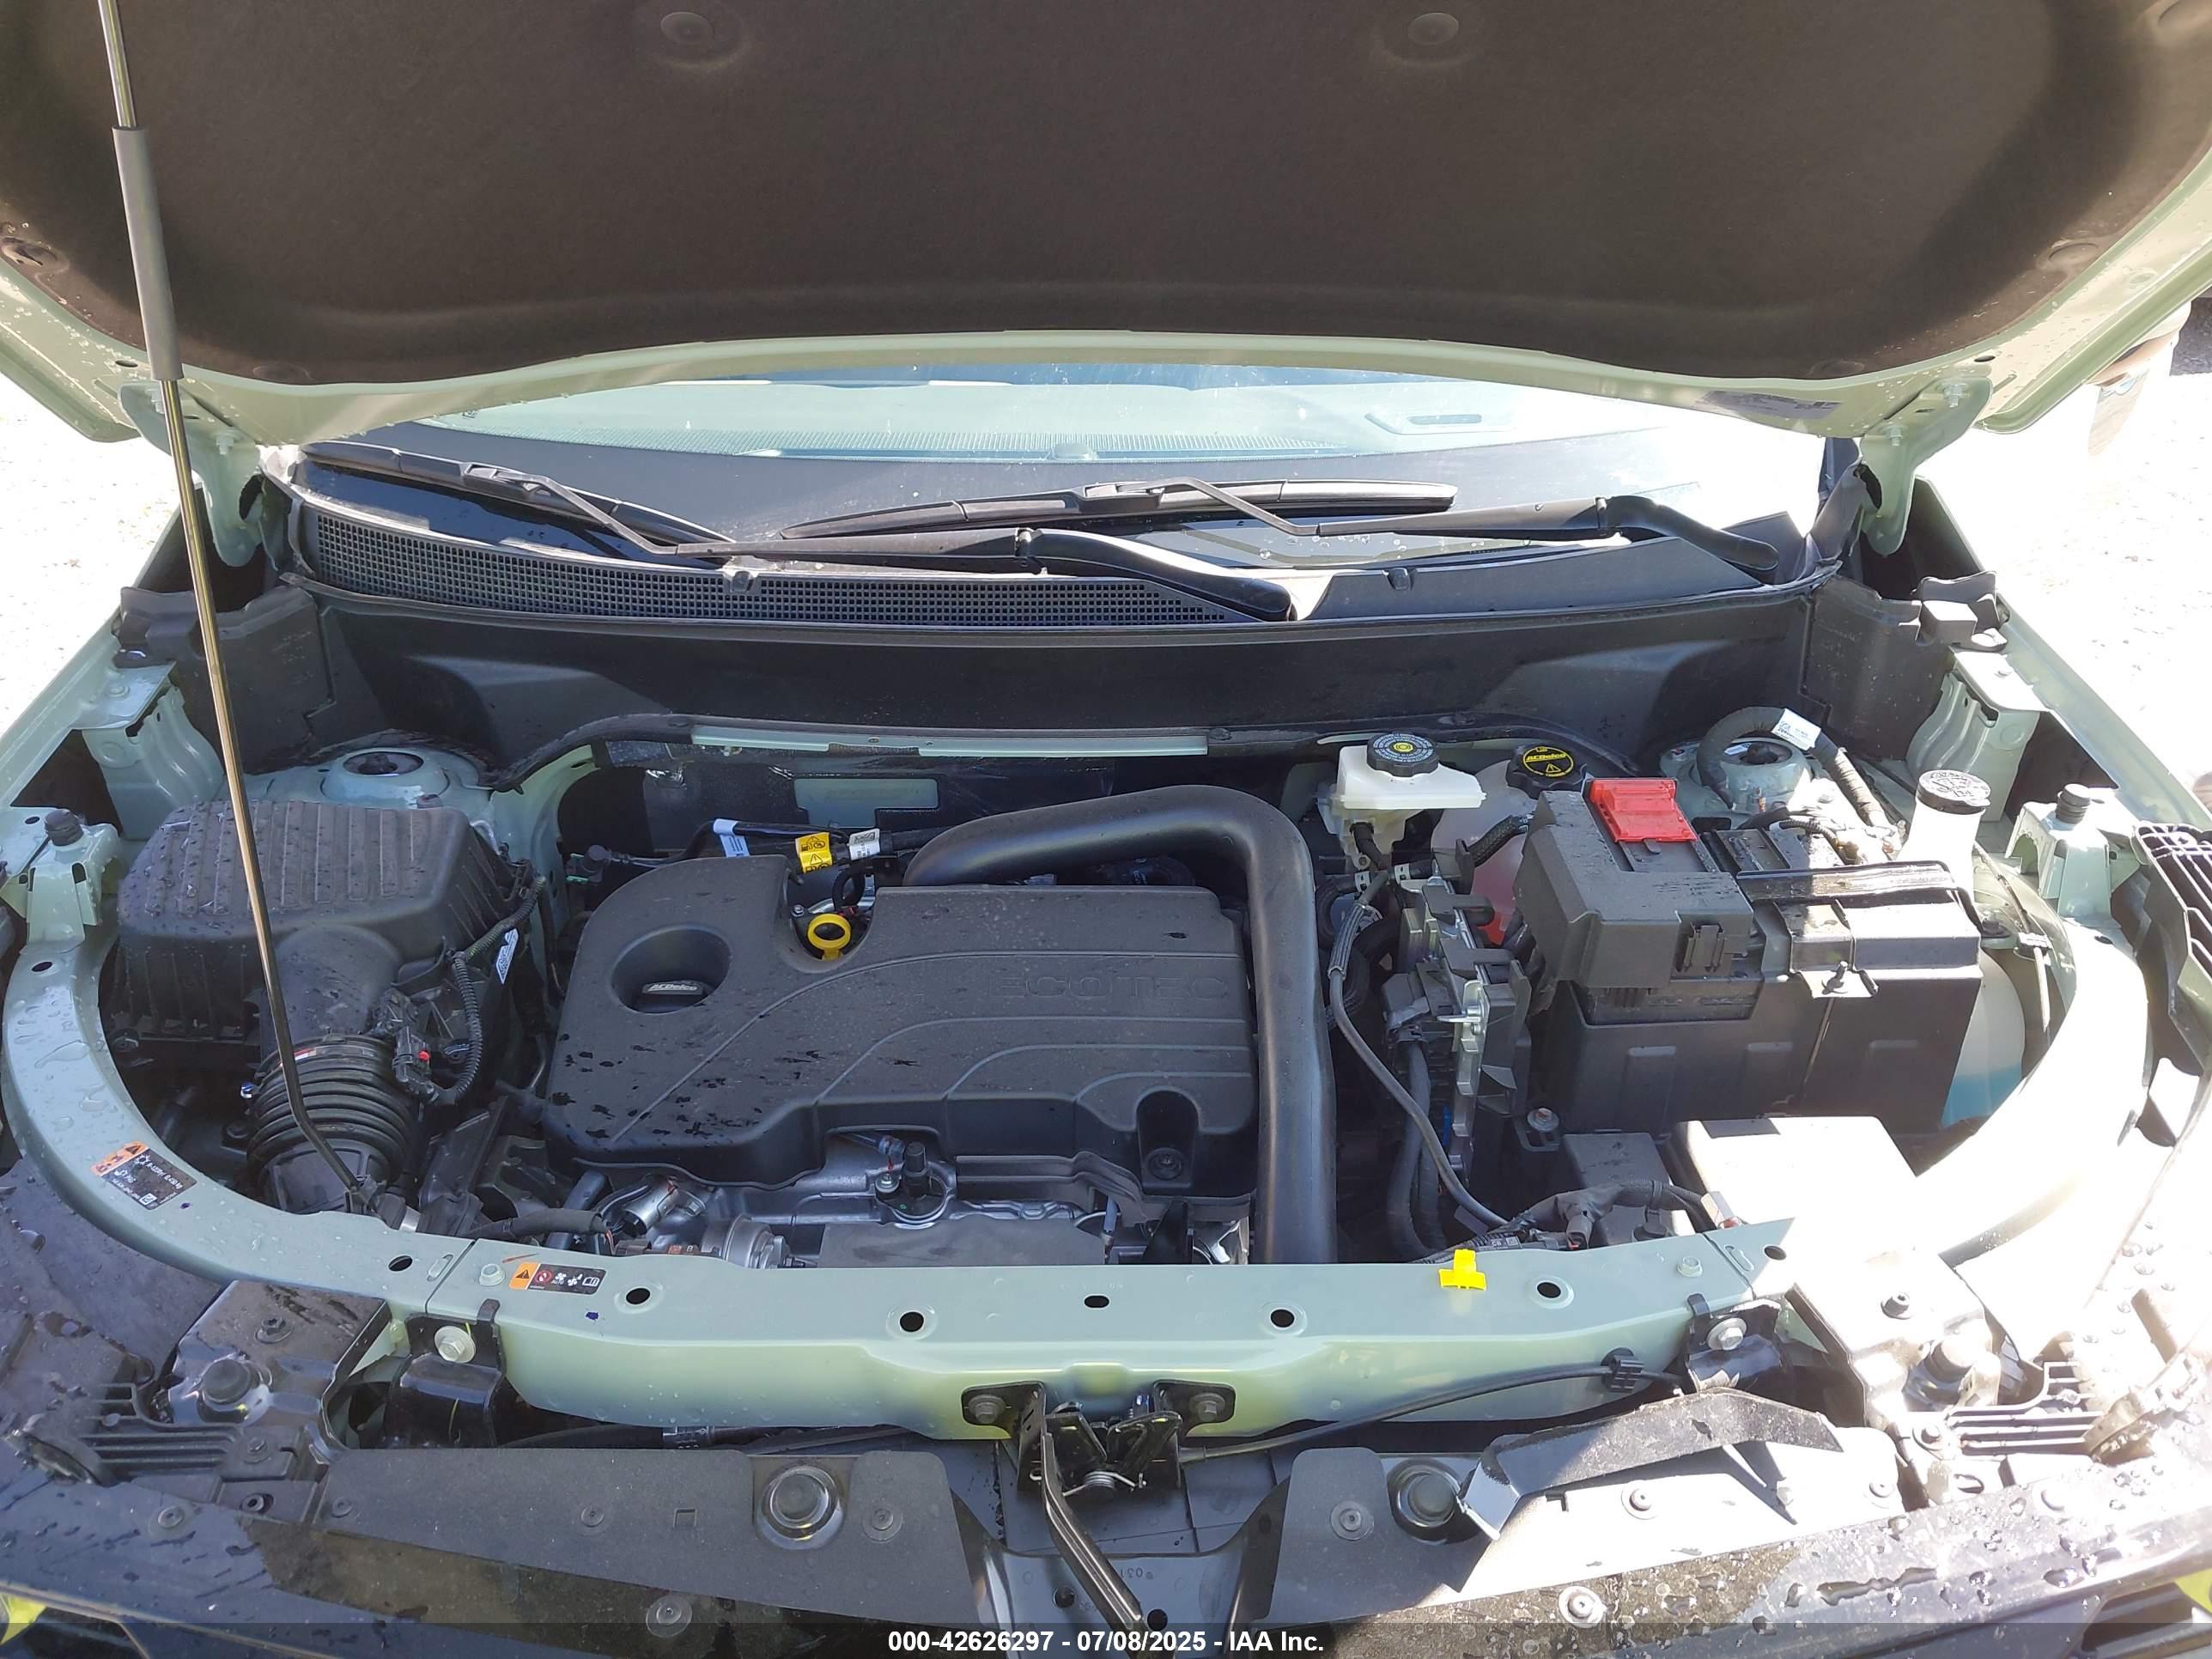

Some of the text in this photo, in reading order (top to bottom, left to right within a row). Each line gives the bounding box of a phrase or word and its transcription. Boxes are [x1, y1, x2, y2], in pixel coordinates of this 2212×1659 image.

[1526, 752, 1567, 762] ACDelco
[647, 983, 697, 992] ACDelco
[988, 975, 1229, 1000] ECOTEC
